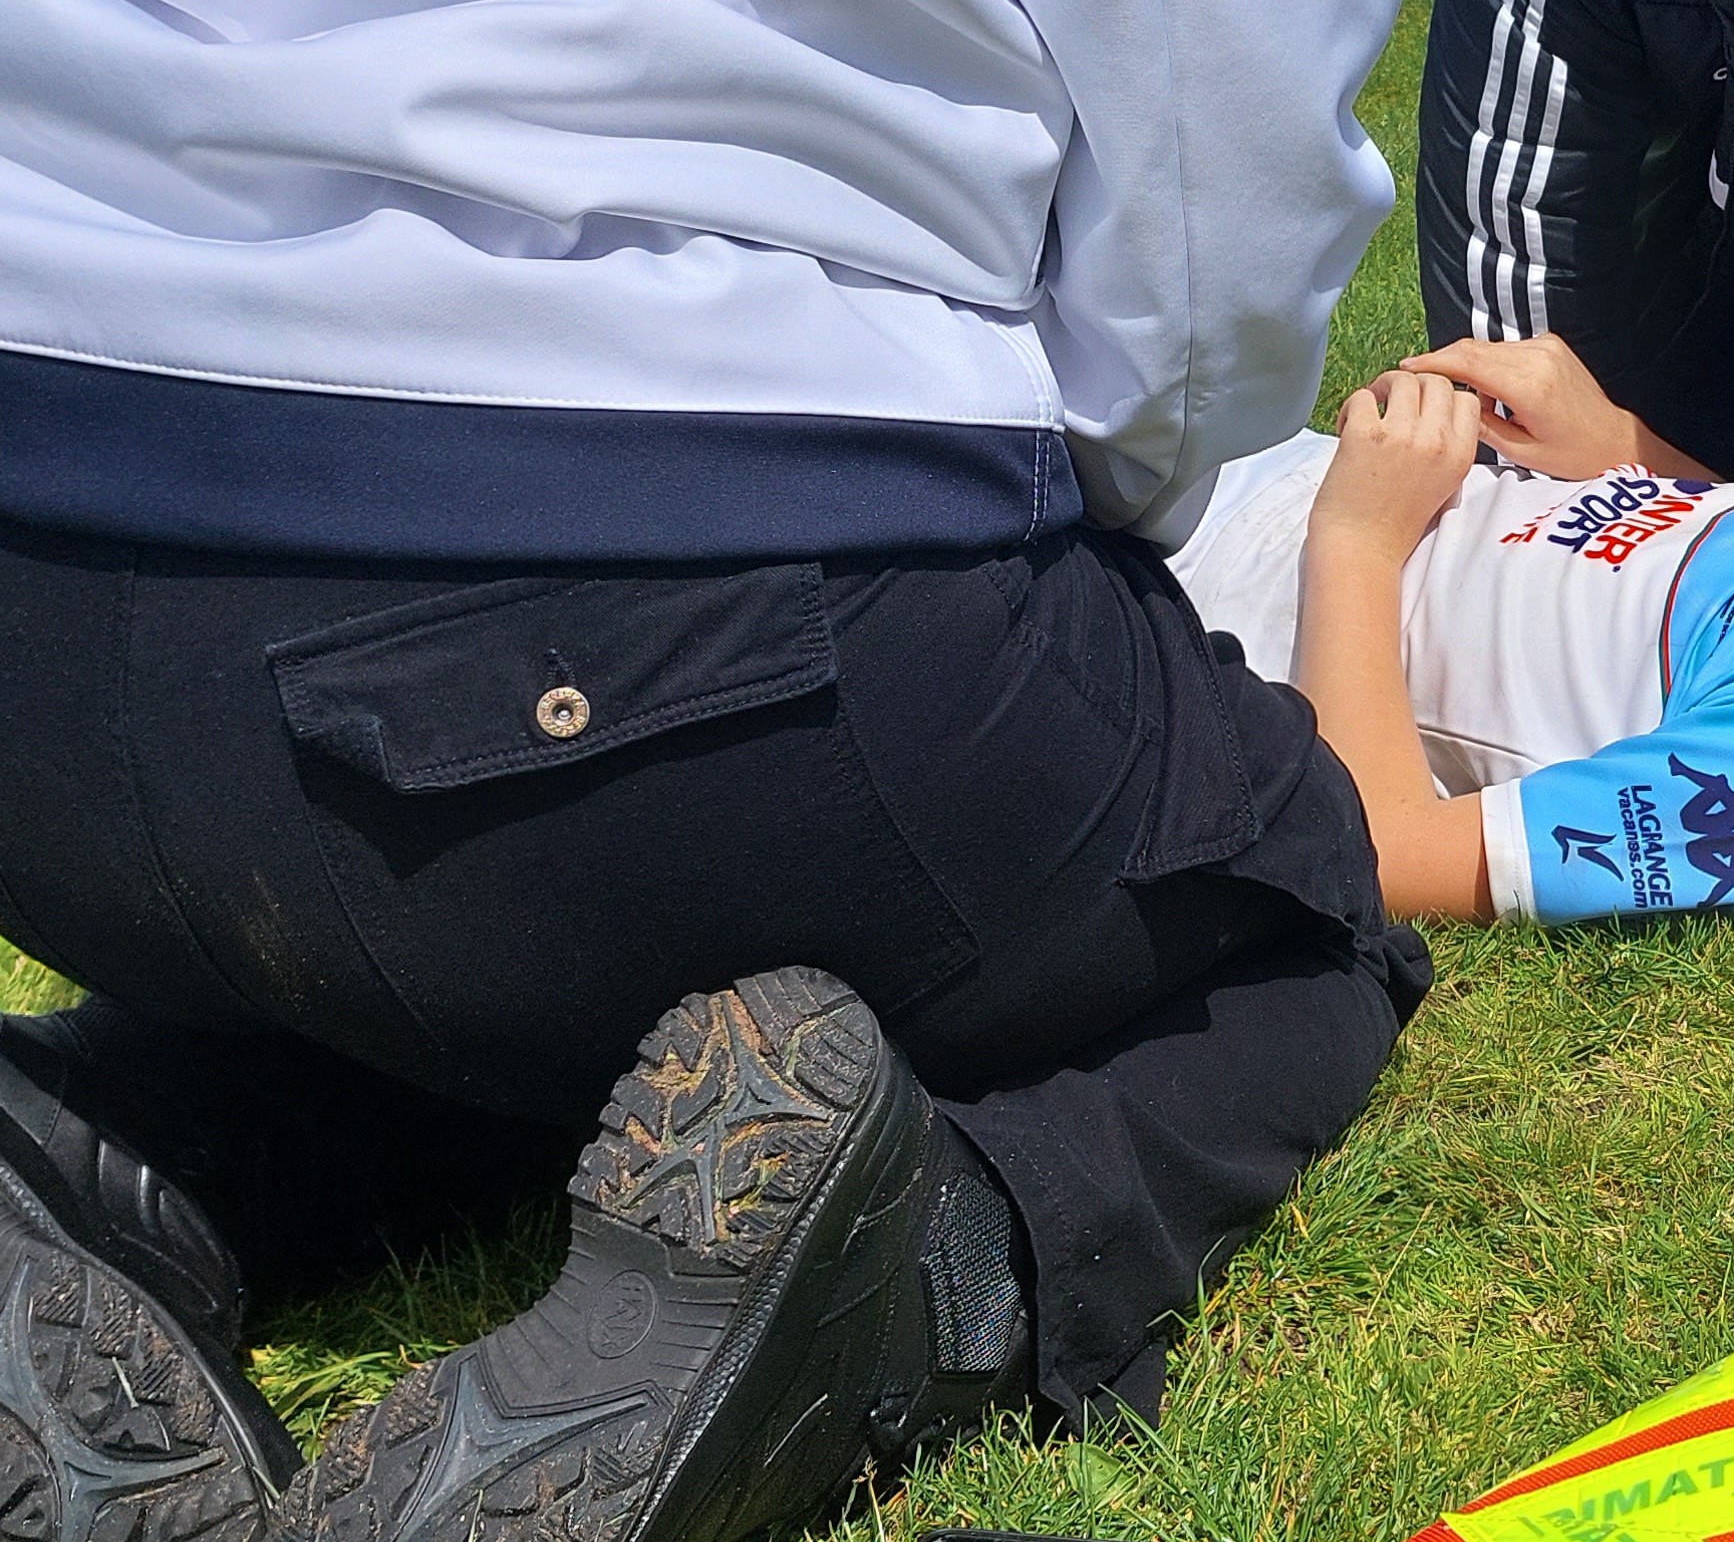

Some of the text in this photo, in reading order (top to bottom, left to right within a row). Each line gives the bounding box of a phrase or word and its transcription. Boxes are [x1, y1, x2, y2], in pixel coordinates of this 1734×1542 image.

[1547, 476, 1661, 554] SPORT
[1584, 494, 1704, 565] INTER
[1630, 784, 1674, 908] LAGRANGE
